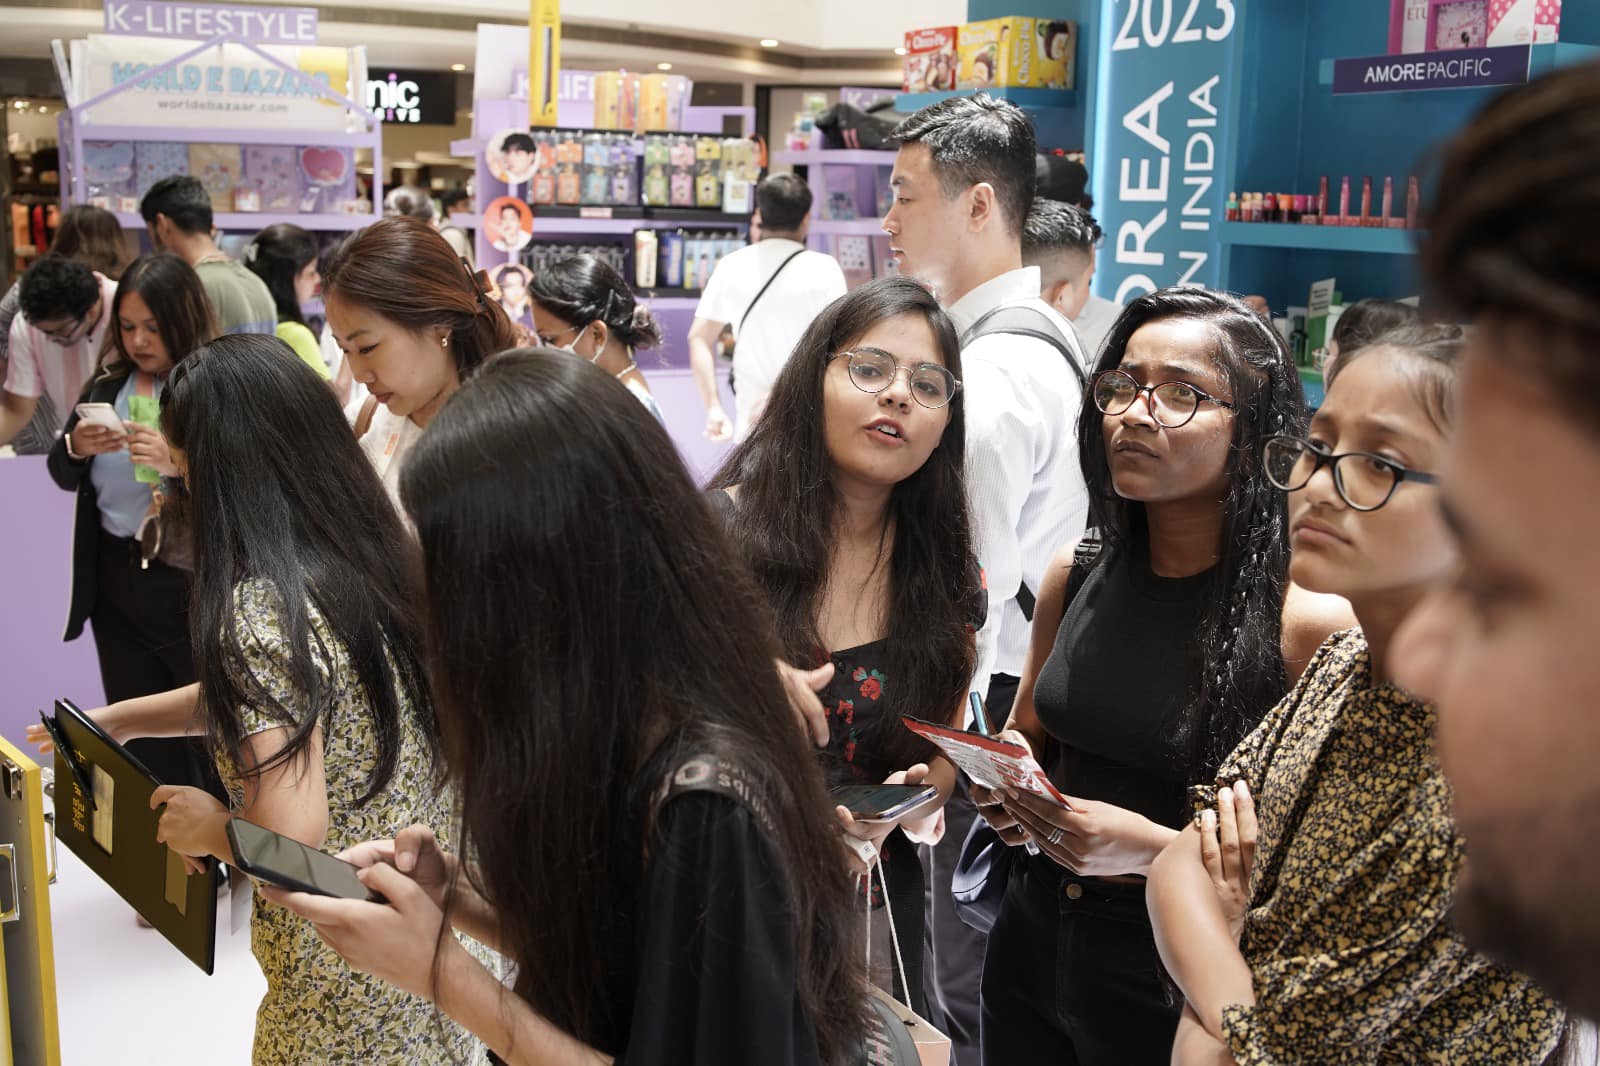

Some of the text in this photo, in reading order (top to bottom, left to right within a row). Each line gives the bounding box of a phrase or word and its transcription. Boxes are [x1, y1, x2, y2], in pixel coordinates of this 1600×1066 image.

[106, 3, 316, 41] K-LIFESTYLE
[1111, 0, 1236, 51] 2023
[1407, 6, 1428, 21] ETU
[1364, 57, 1492, 84] AMOREPACIFIC
[365, 72, 420, 109] nic
[1114, 80, 1175, 307] OREA
[1176, 74, 1220, 290] N INDIA
